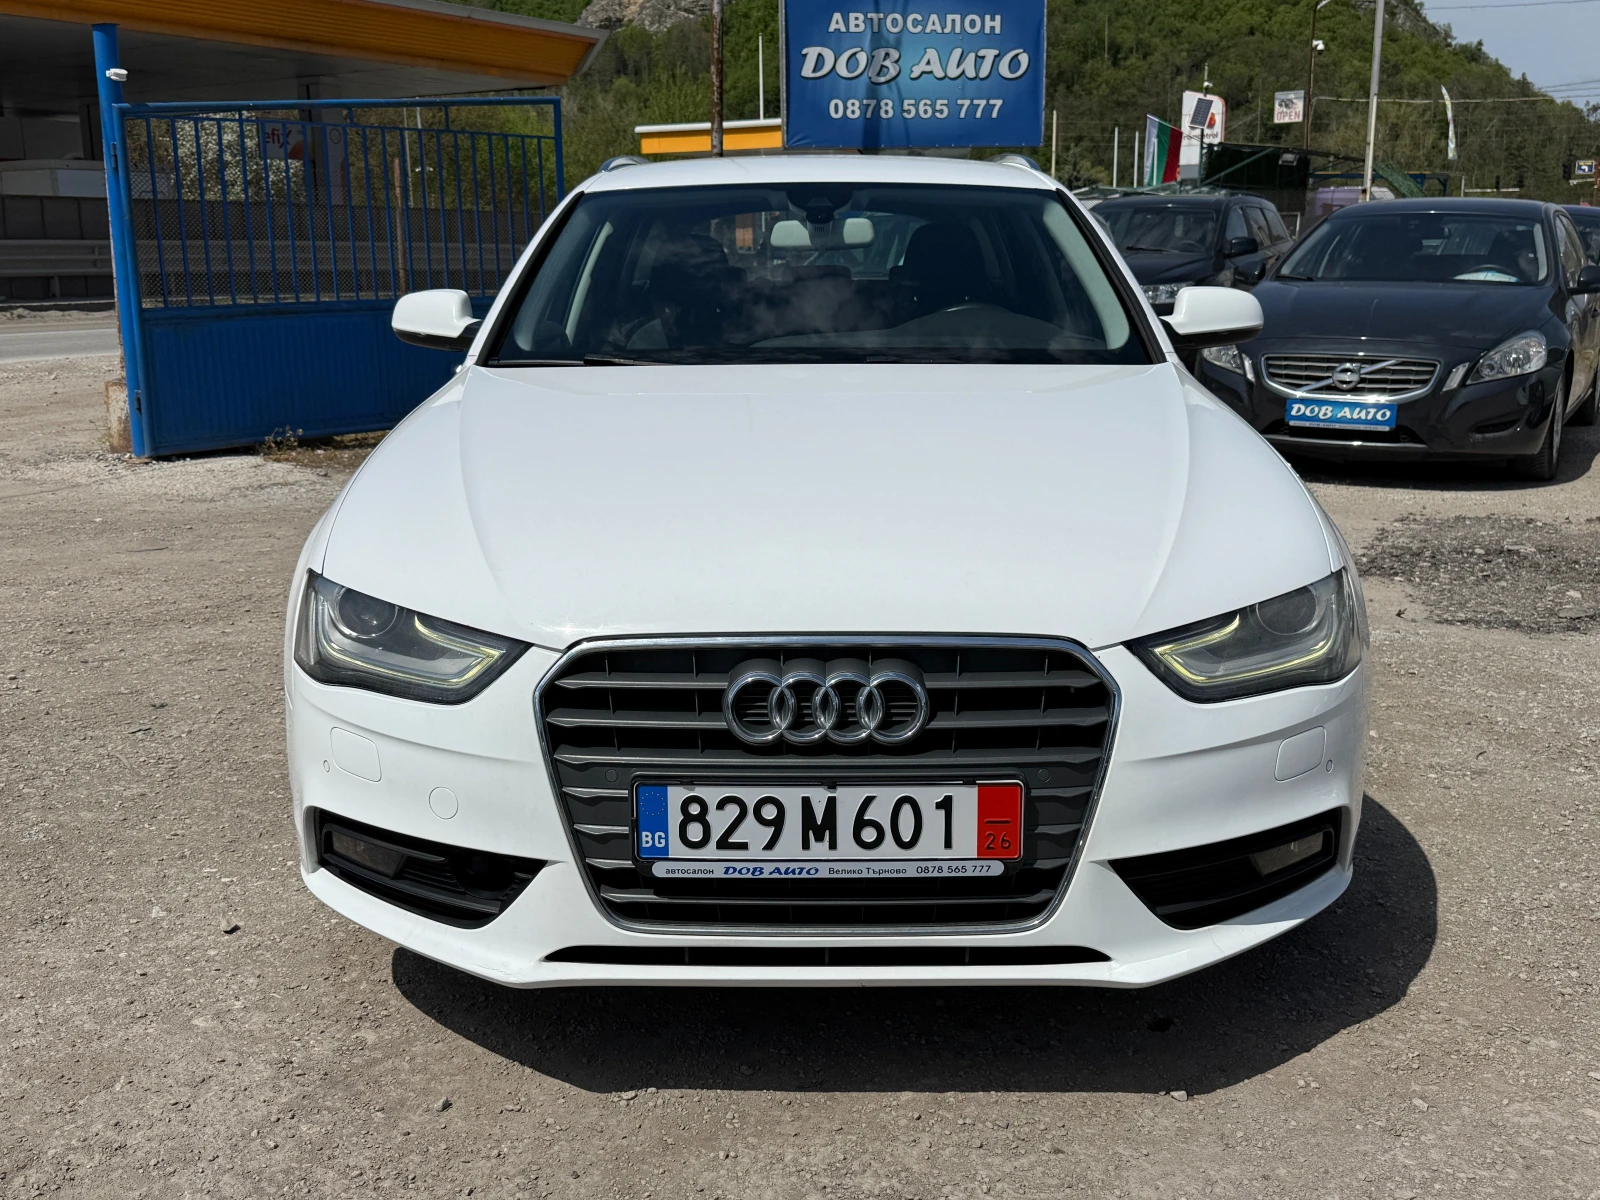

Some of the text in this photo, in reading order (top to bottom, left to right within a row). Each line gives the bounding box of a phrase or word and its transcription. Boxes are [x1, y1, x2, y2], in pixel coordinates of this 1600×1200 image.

[828, 12, 1001, 35] АВТОСАЛОН
[800, 46, 1030, 83] DOB AUTO
[828, 98, 1003, 119] 0878 565 777
[1276, 109, 1301, 121] OPEN
[1290, 403, 1391, 421] DOB AUTO
[678, 793, 786, 851] 829
[852, 793, 953, 850] 601
[641, 831, 666, 848] BG
[985, 832, 1011, 850] 26
[665, 864, 992, 877] автосалон DOB AUTO Велико Търново 0878 565 777
